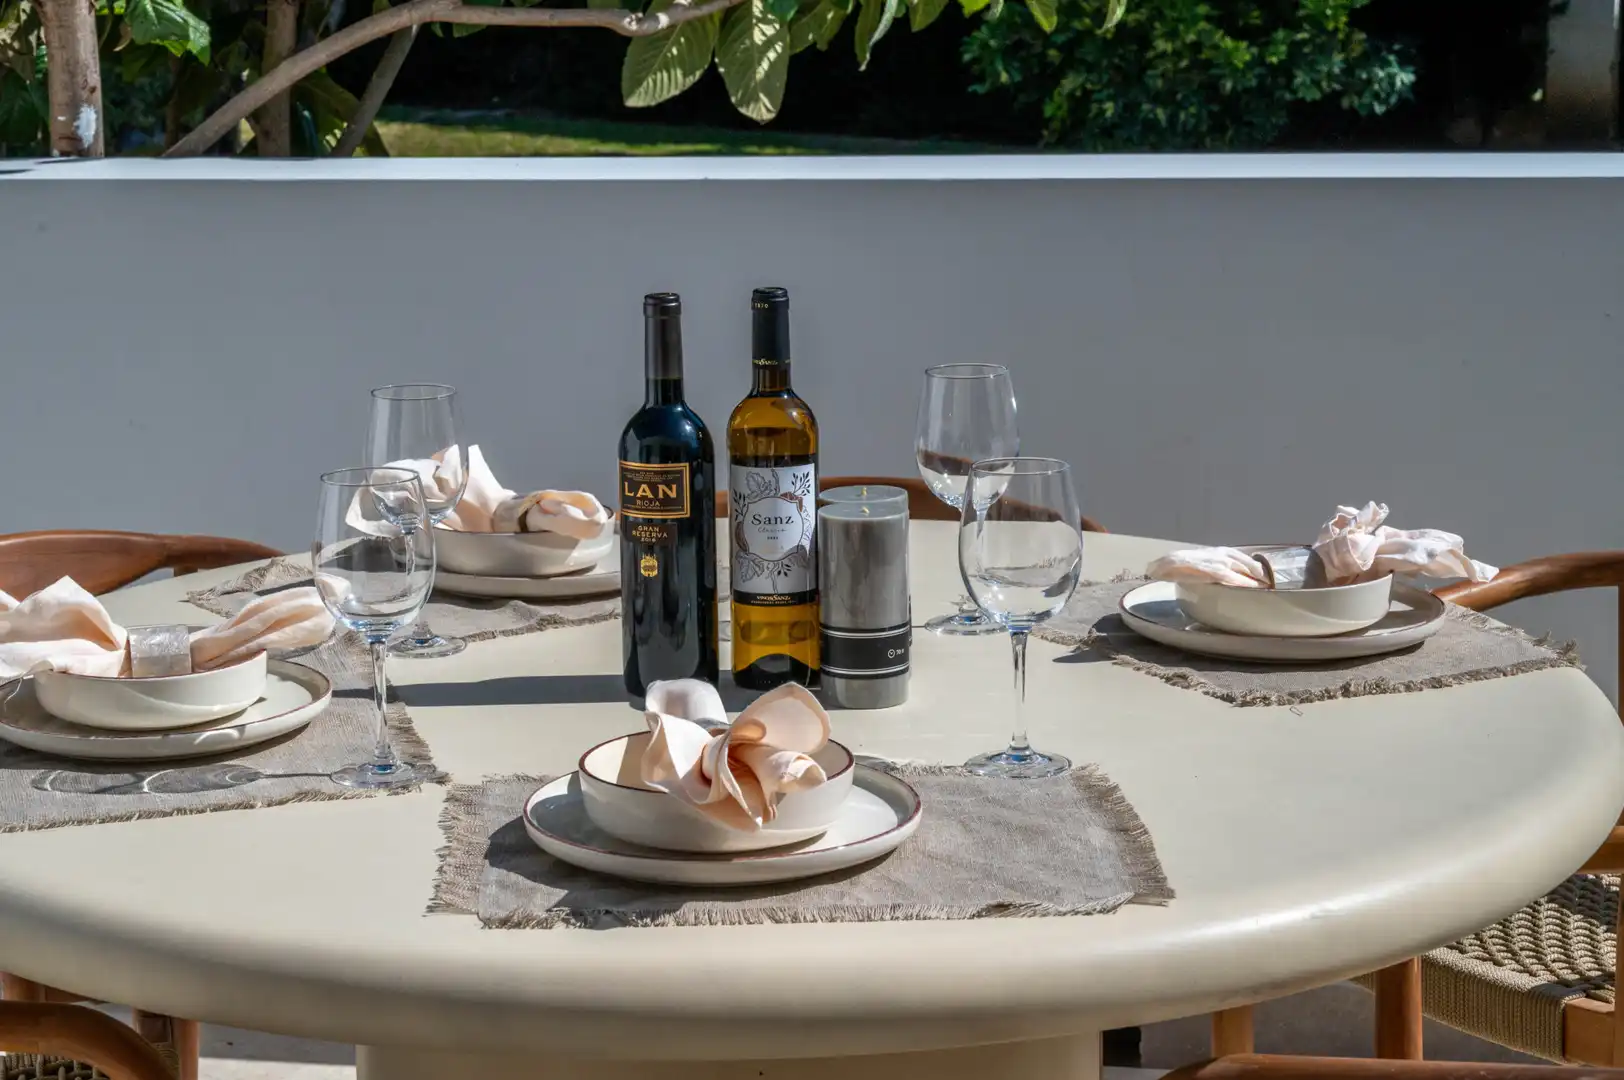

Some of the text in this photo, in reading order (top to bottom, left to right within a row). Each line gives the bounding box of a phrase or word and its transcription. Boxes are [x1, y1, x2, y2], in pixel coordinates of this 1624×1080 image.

[624, 481, 677, 499] LAN
[636, 499, 661, 507] RIOJA
[751, 513, 795, 526] Sanz
[631, 530, 668, 538] RESERVA
